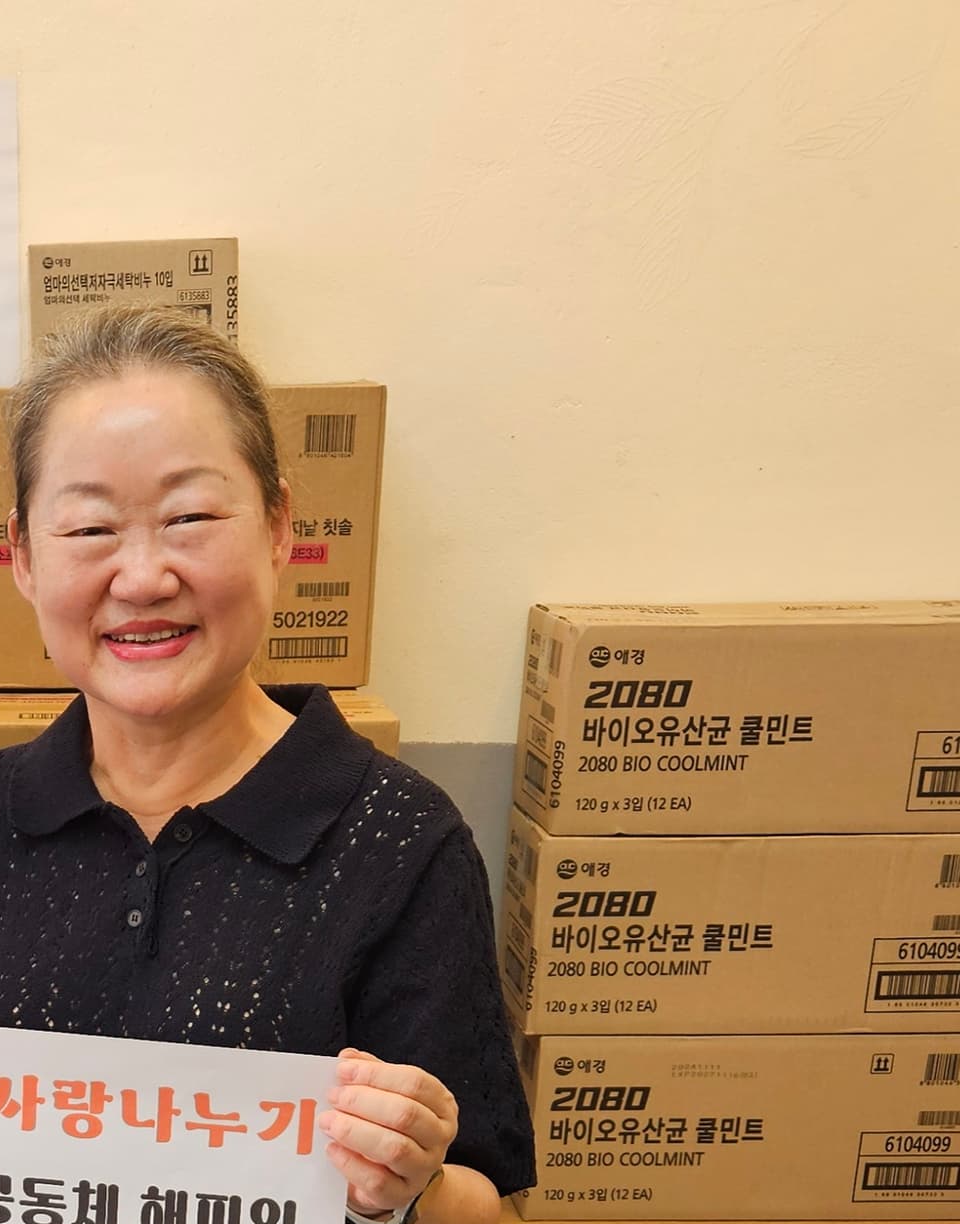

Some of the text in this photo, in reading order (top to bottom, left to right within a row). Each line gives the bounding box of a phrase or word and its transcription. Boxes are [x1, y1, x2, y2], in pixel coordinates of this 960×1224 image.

[154, 270, 174, 289] 10입
[226, 274, 238, 346] 135883
[322, 517, 353, 537] 칫솔
[273, 610, 349, 629] 5021922
[614, 648, 646, 665] 애경
[583, 679, 693, 709] 2080
[582, 714, 814, 748] 바이오유산균 쿨민트
[577, 753, 749, 772] 2080 BIO COOLMINT
[549, 740, 566, 809] 6104099
[575, 797, 597, 811] 120
[600, 801, 609, 814] g
[623, 796, 643, 812] 3입
[646, 796, 667, 812] (12
[669, 796, 692, 812] EA)
[581, 861, 611, 877] 애경
[552, 890, 657, 918] 2080
[551, 923, 774, 954] 바이오유산균 쿨민트
[547, 959, 711, 977] 2080 BIO COOLMINT
[545, 1000, 567, 1013] 120
[569, 1003, 577, 1016] g
[591, 999, 611, 1014] 3입
[614, 999, 634, 1014] (12
[636, 998, 658, 1014] EA)
[577, 1058, 607, 1074] 애경
[549, 1086, 651, 1112] 2080
[549, 1117, 764, 1145] 바이오유산균 쿨민트
[884, 1136, 952, 1153] 6104099
[546, 1151, 705, 1168] 2080 BIO COOLMINT
[544, 1188, 565, 1201] 120
[567, 1191, 576, 1203] g
[588, 1188, 608, 1202] 3입
[610, 1187, 630, 1202] (12
[632, 1187, 653, 1201] EA)
